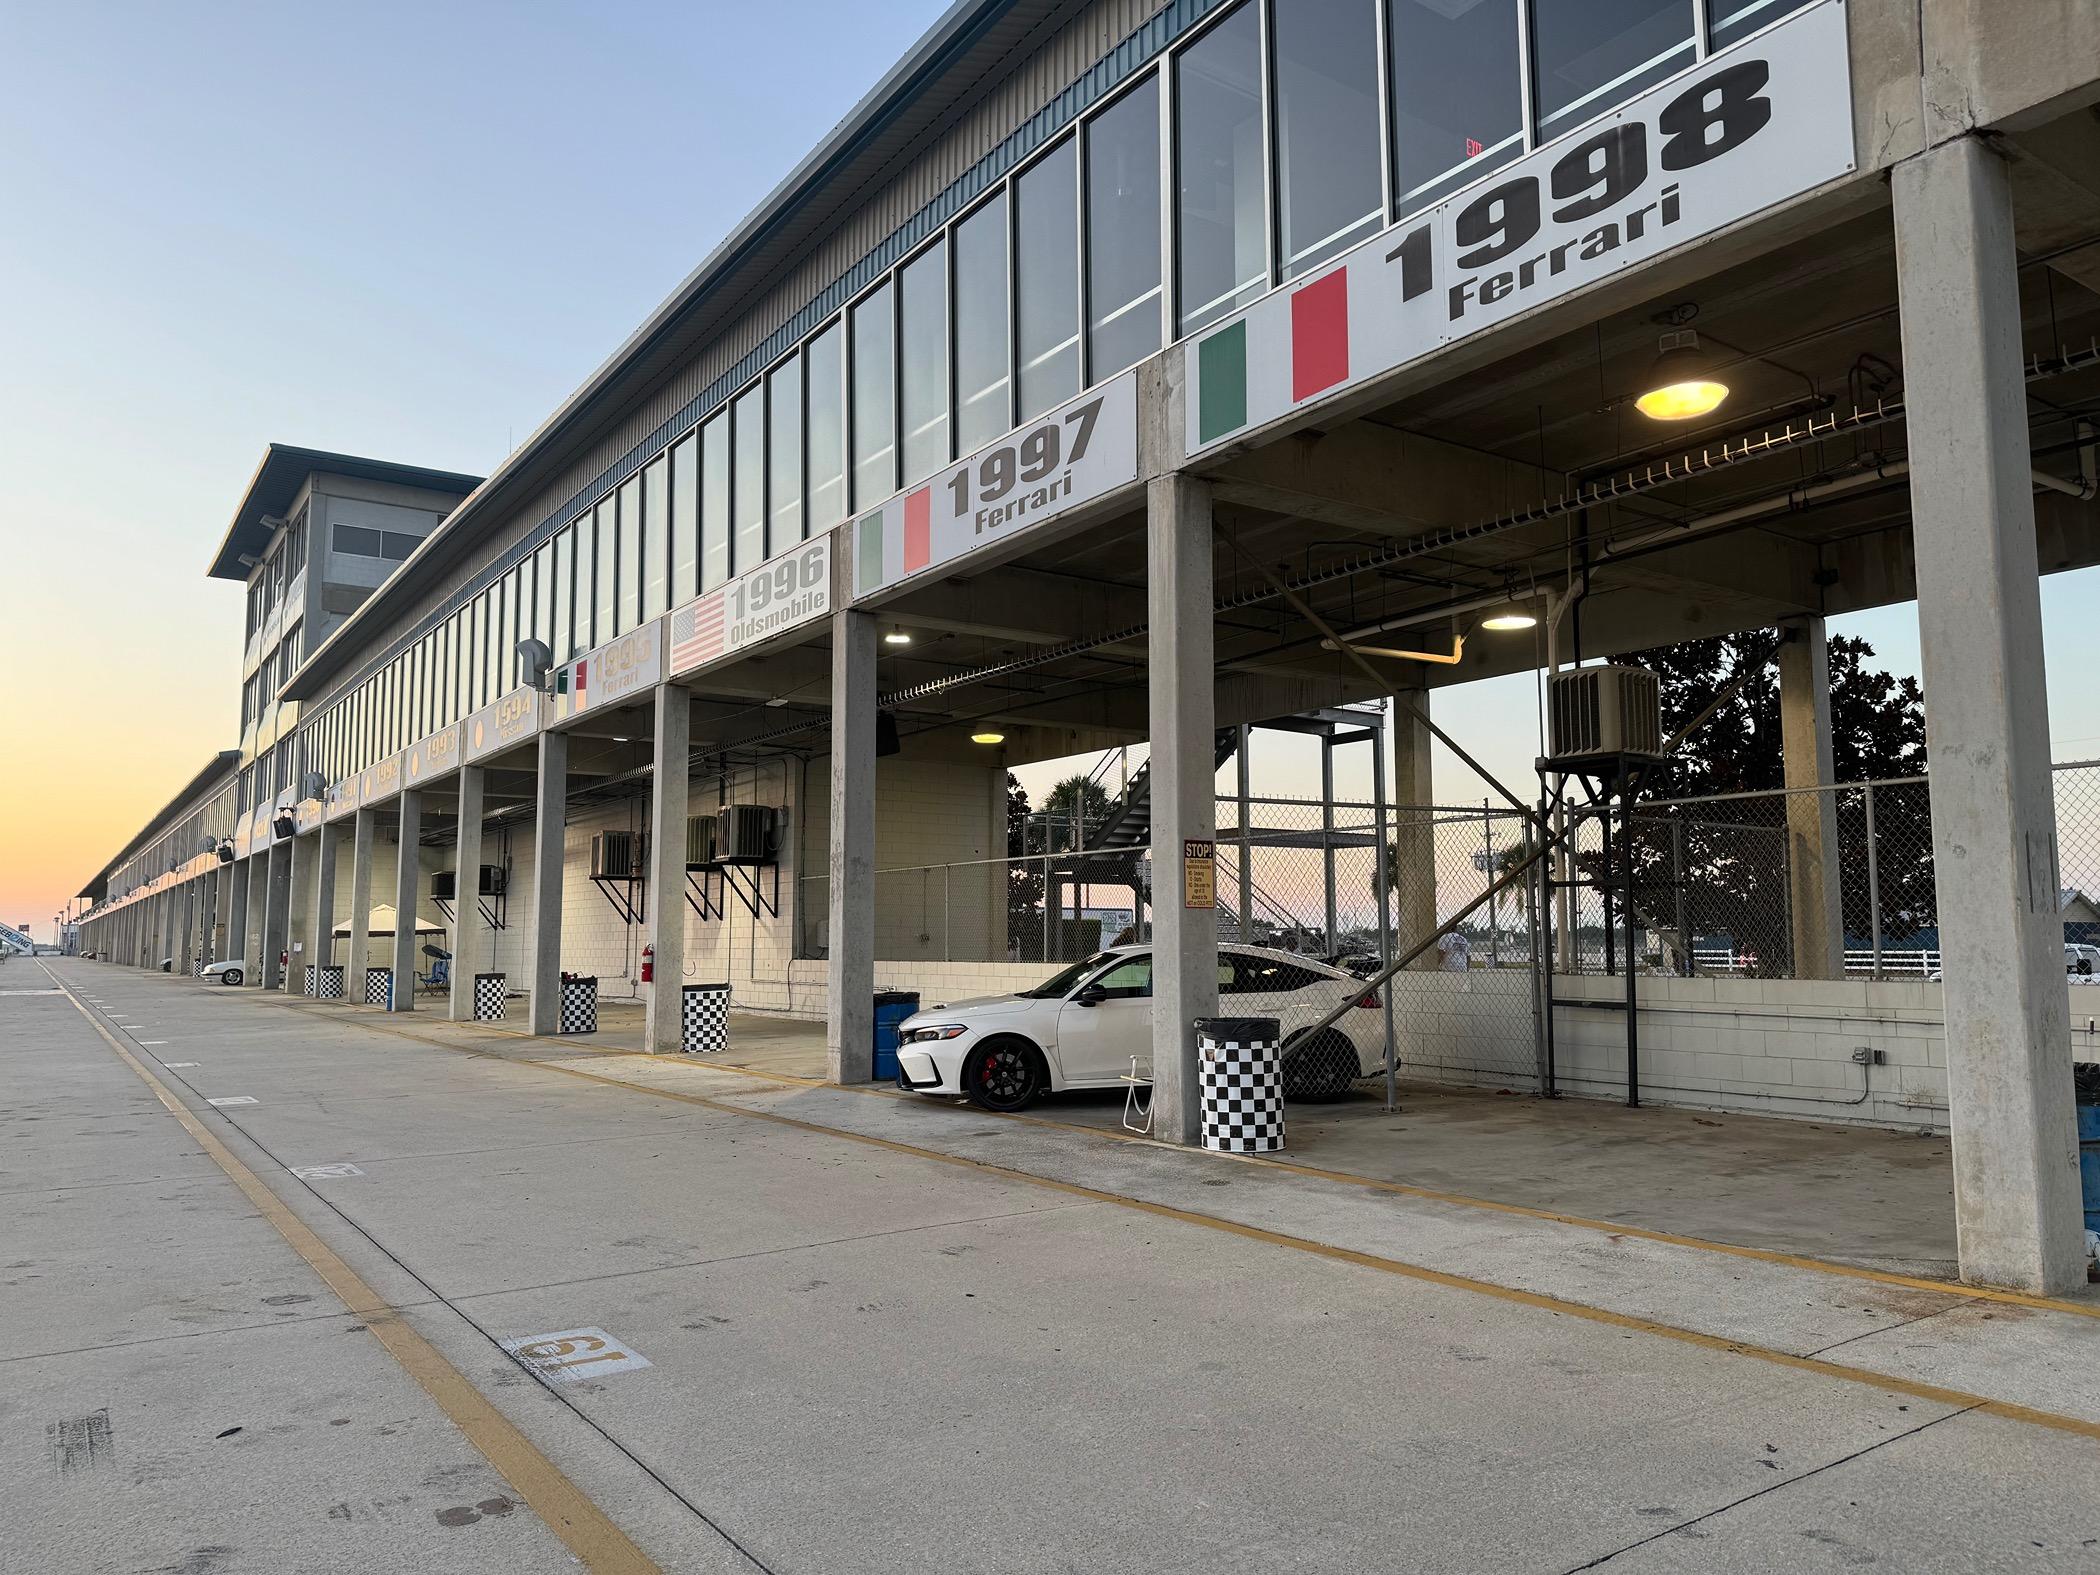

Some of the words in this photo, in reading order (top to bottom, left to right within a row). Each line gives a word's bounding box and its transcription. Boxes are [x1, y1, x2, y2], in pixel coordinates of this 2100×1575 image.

[1466, 138, 1482, 157] EXIT
[1385, 59, 1771, 303] 1998
[1449, 182, 1680, 322] Ferrari
[948, 396, 1104, 517] 1997
[975, 469, 1072, 535] Ferrari
[731, 546, 824, 621] 1996
[731, 592, 825, 645] Oldsmobile
[594, 629, 652, 683] 1995
[602, 666, 639, 696] Ferrari
[1186, 843, 1212, 857] STOP!
